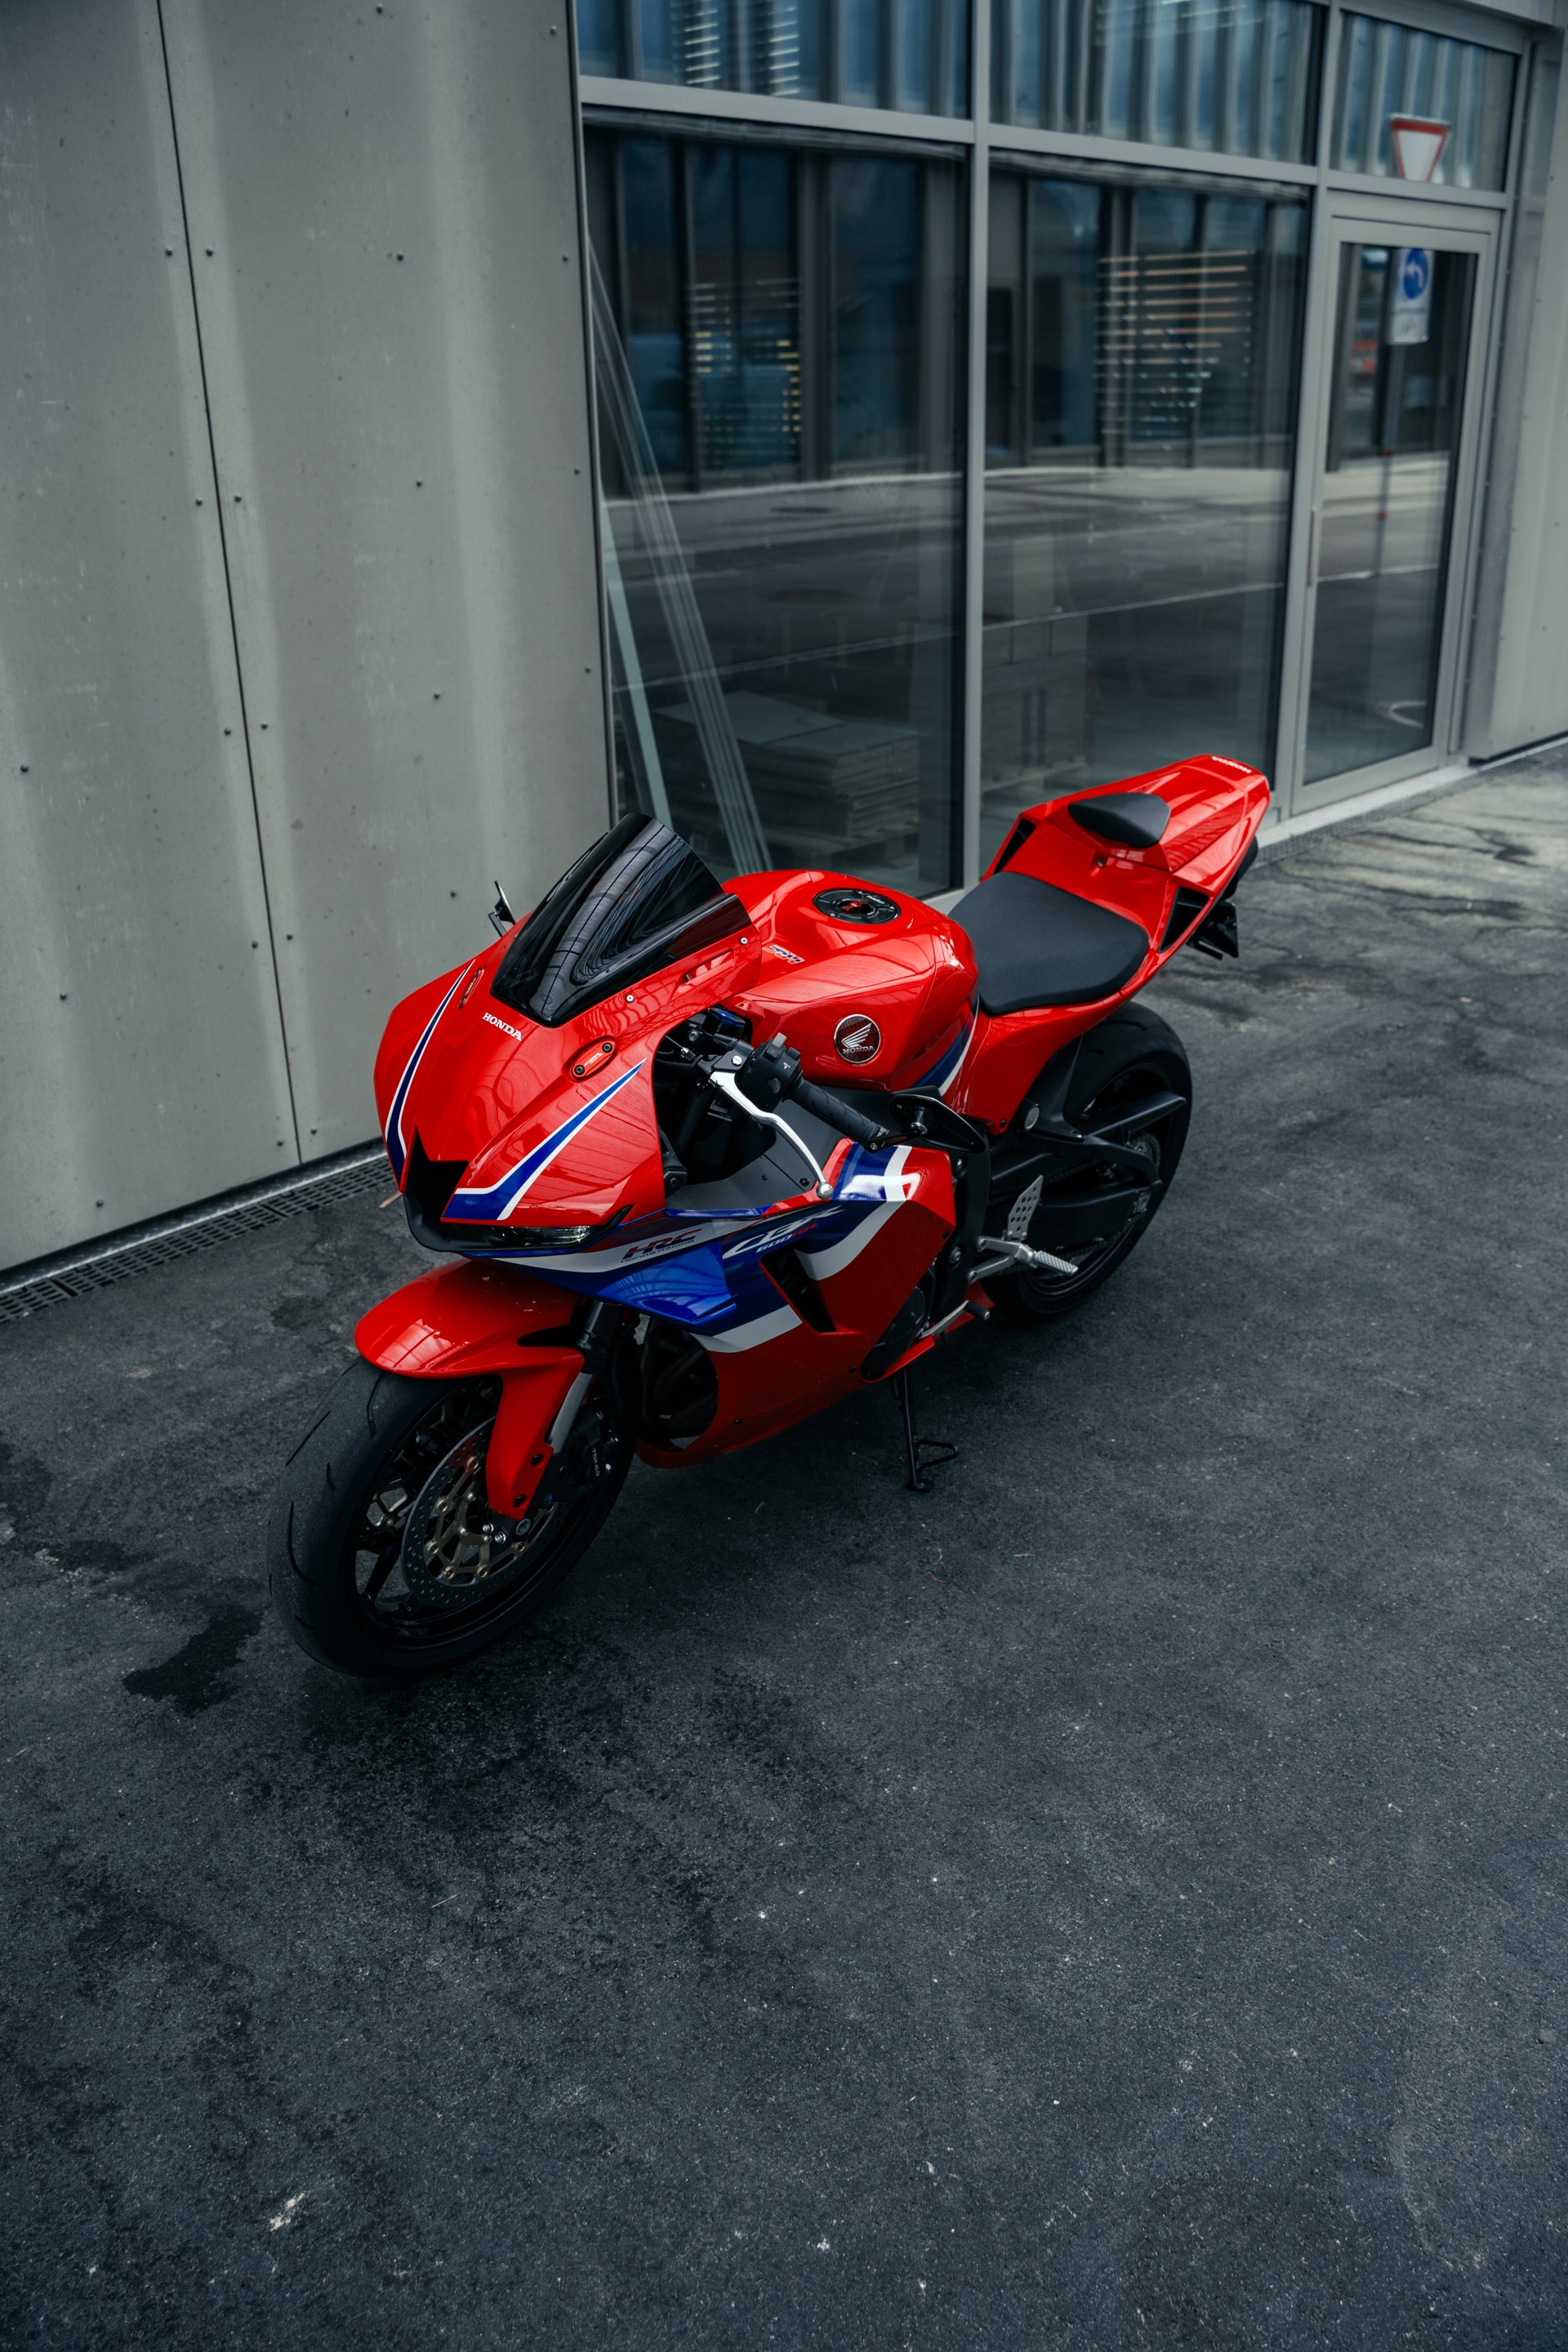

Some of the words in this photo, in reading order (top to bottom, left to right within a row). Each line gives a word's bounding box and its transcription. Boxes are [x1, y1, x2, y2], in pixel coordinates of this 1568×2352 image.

[482, 1012, 522, 1042] HONDA
[842, 1045, 875, 1054] HONDA
[621, 1227, 702, 1260] HRC
[722, 1205, 846, 1260] CBR
[755, 1223, 817, 1254] 600RR
[621, 1251, 656, 1264] Honda
[657, 1239, 695, 1254] RACING
